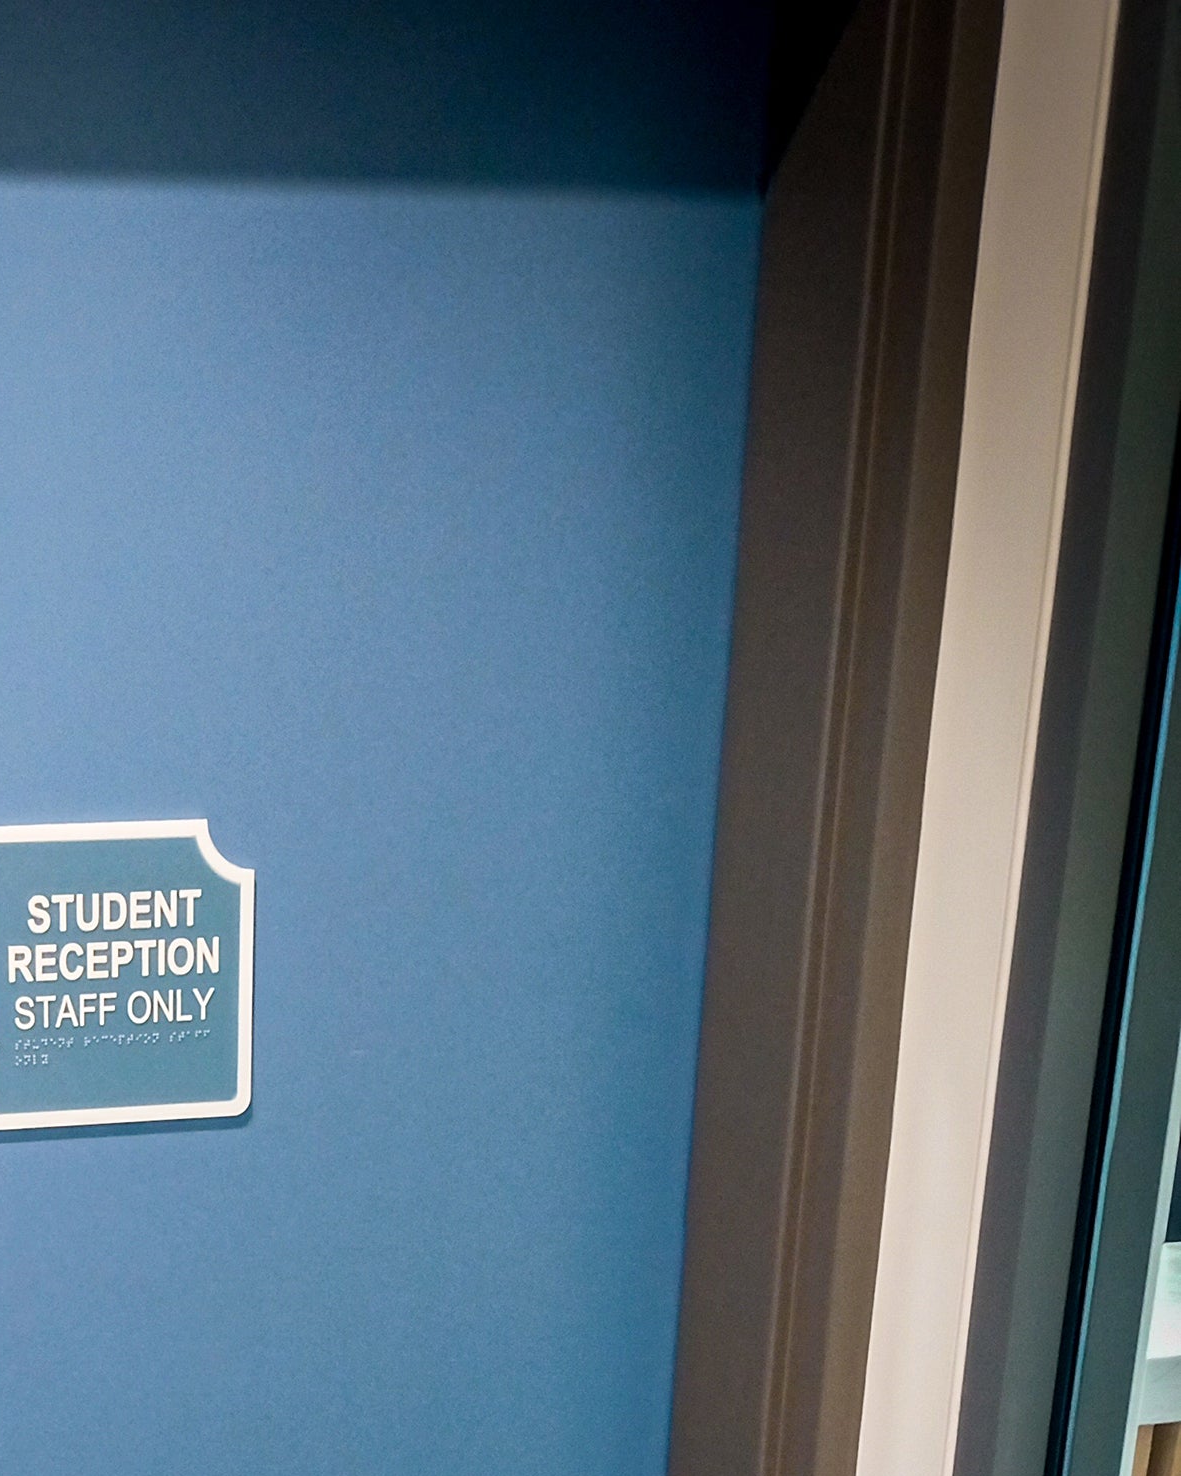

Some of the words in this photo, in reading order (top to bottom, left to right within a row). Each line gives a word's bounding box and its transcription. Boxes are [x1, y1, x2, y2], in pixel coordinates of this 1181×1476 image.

[27, 888, 202, 934] STUDENT
[7, 936, 220, 983] RECEPTION
[14, 992, 118, 1030] STAFF
[127, 987, 215, 1024] ONLY
